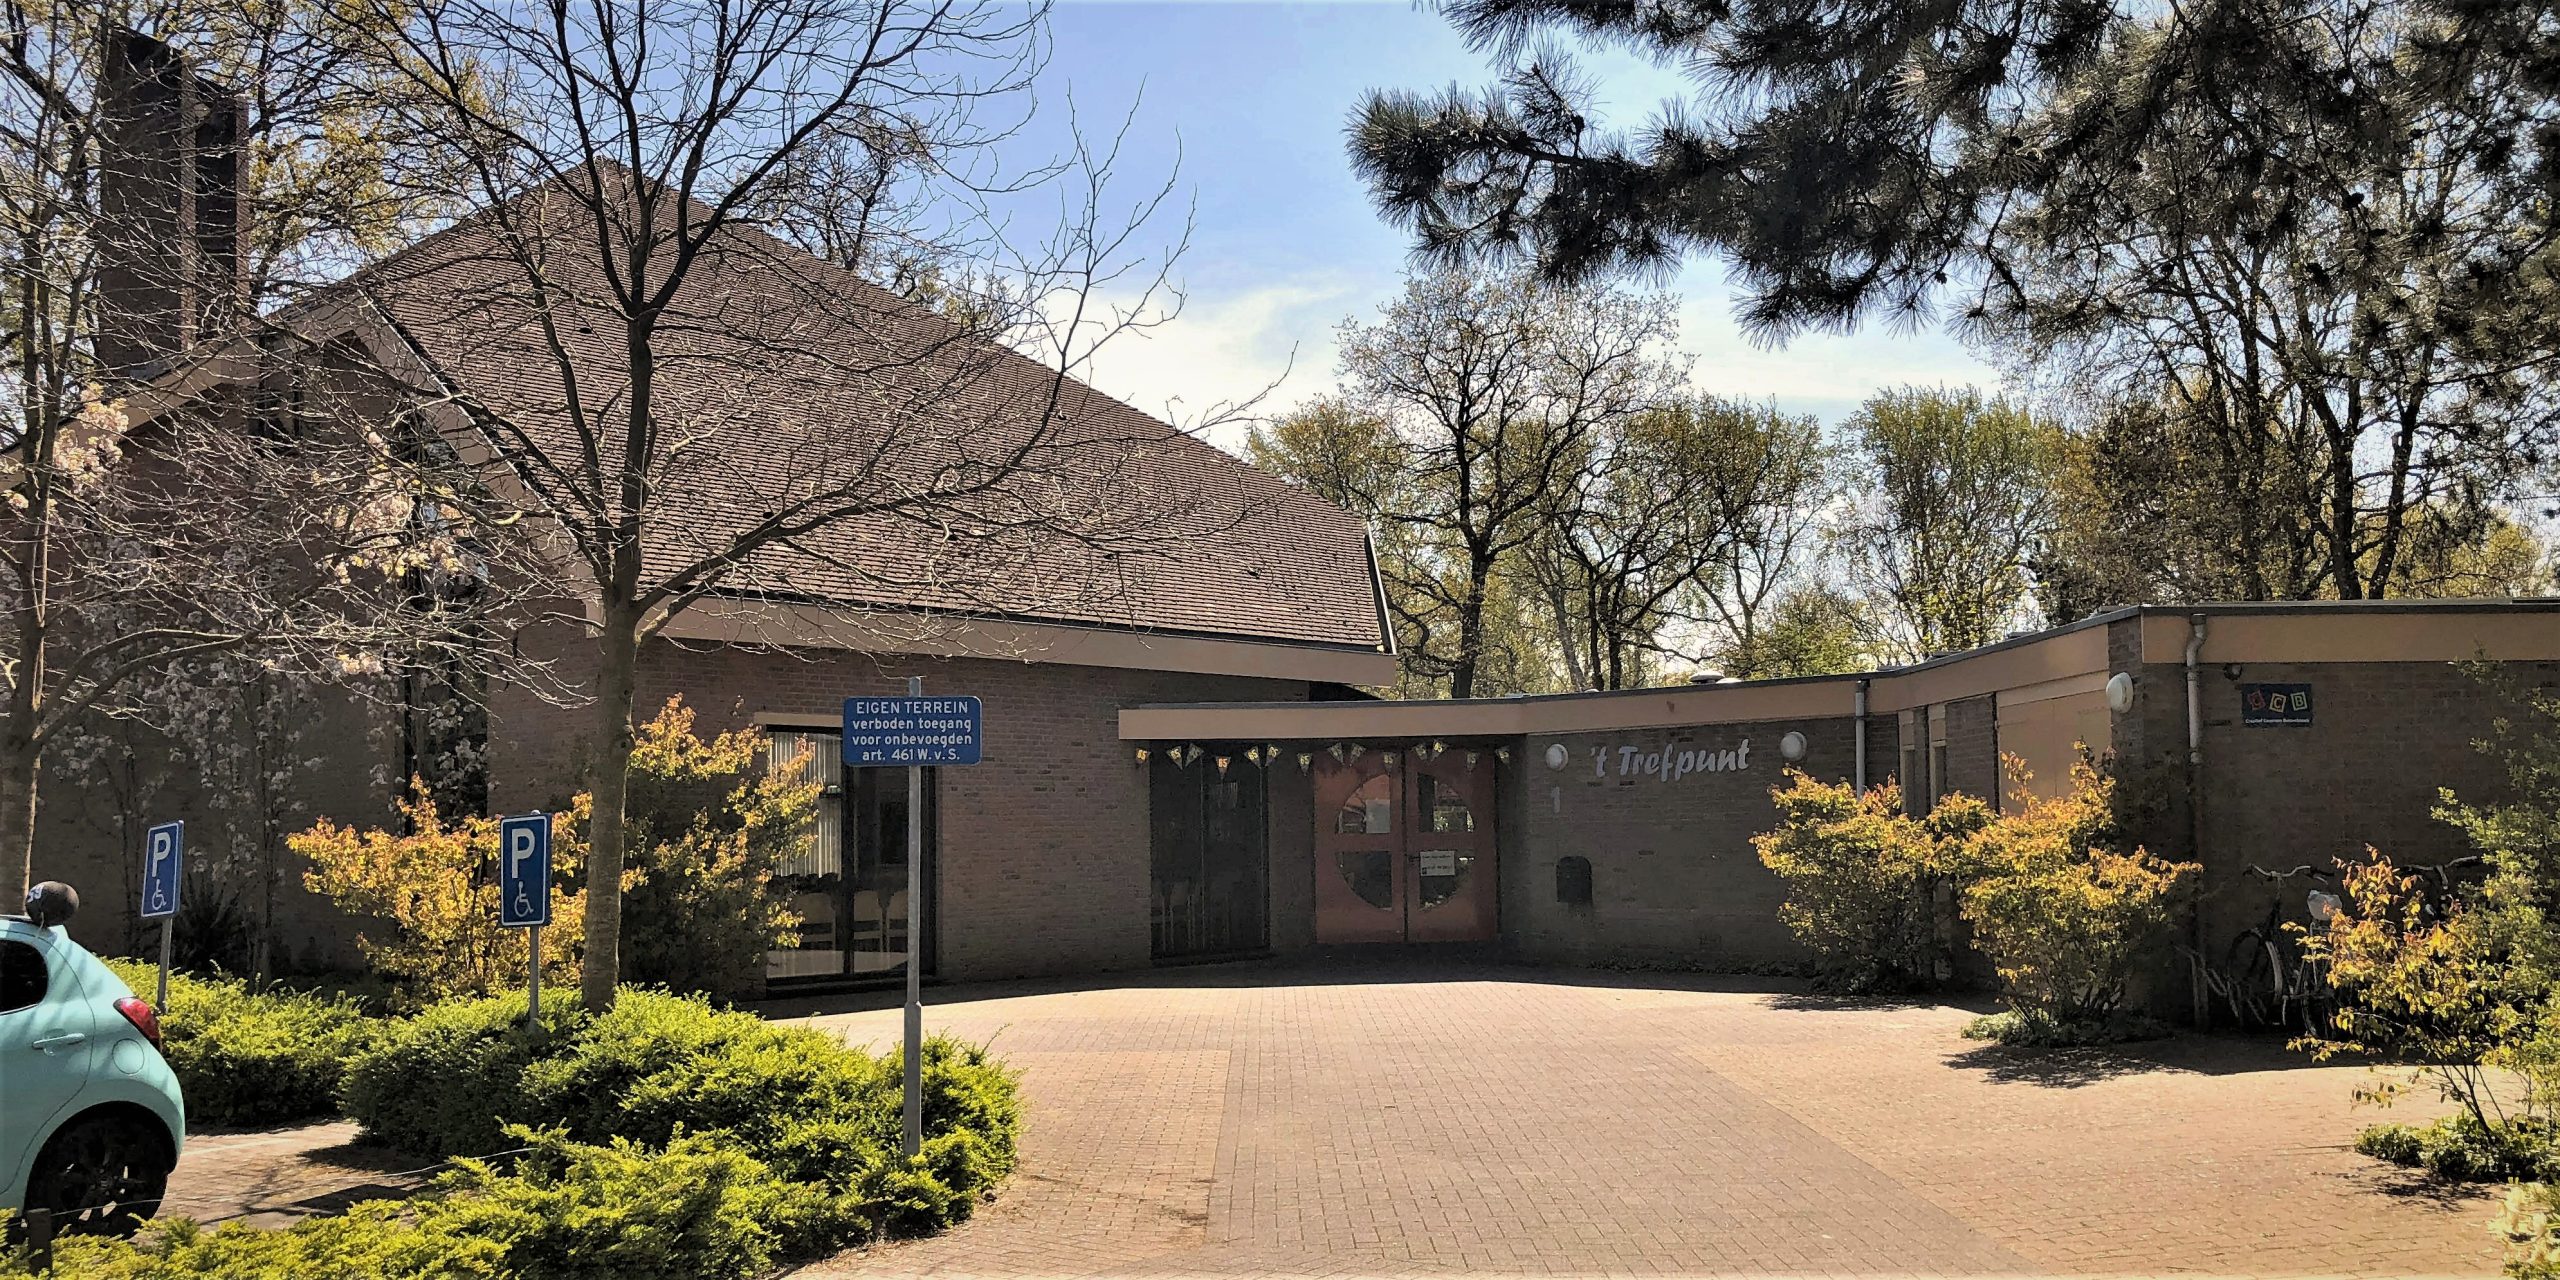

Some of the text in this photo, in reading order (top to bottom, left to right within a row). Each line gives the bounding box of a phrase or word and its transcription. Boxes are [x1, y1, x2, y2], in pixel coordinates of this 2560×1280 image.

[856, 701, 968, 714] EIGEN TERREIN
[852, 717, 972, 732] verboden toegang
[852, 733, 972, 748] voor onbevoegden
[862, 749, 886, 761] art.
[891, 748, 914, 761] 461
[1618, 739, 1749, 782] Trefpunt
[151, 831, 171, 878] P
[511, 827, 536, 879] P
